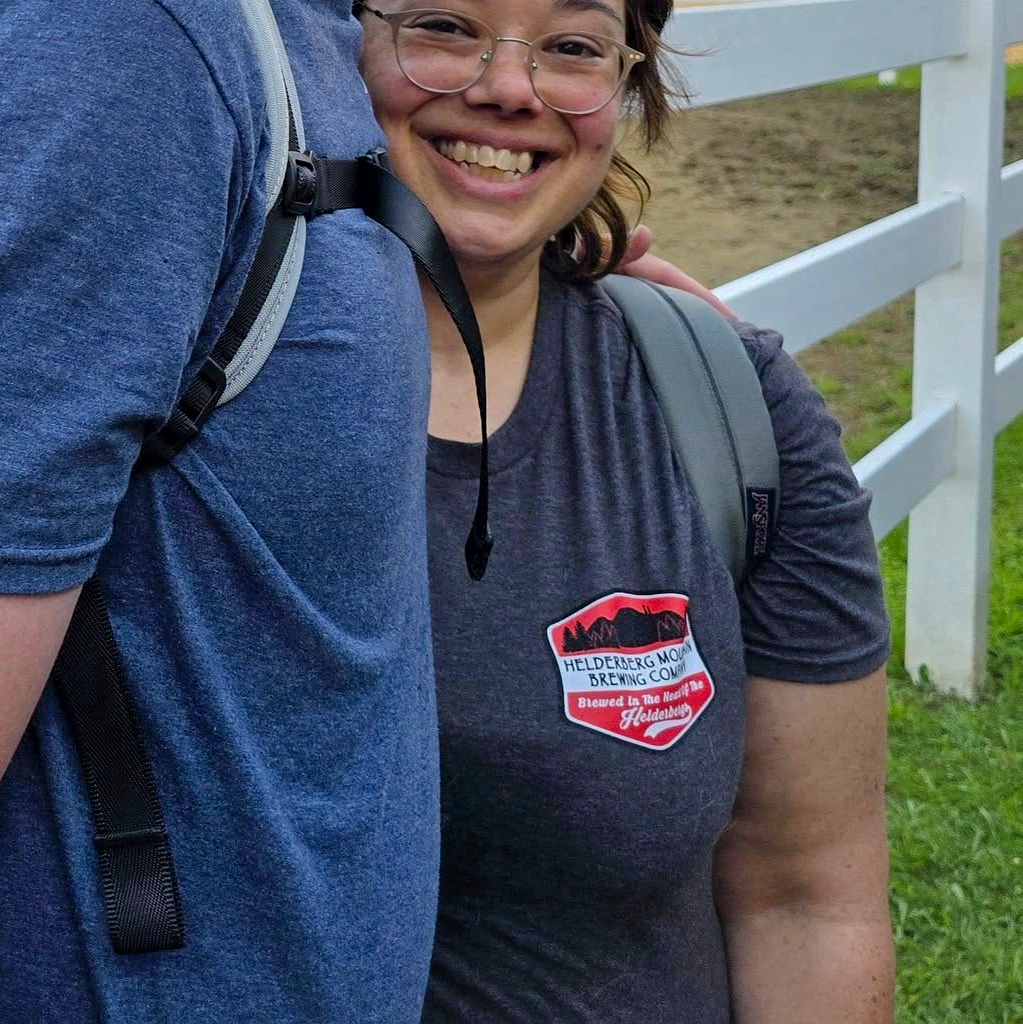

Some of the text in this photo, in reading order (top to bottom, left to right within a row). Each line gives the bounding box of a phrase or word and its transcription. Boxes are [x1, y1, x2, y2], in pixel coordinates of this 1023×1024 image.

[563, 655, 655, 672] HELDERBERG
[588, 672, 647, 687] BREWING
[577, 696, 624, 708] Brewed
[627, 695, 640, 707] In
[641, 693, 661, 706] The
